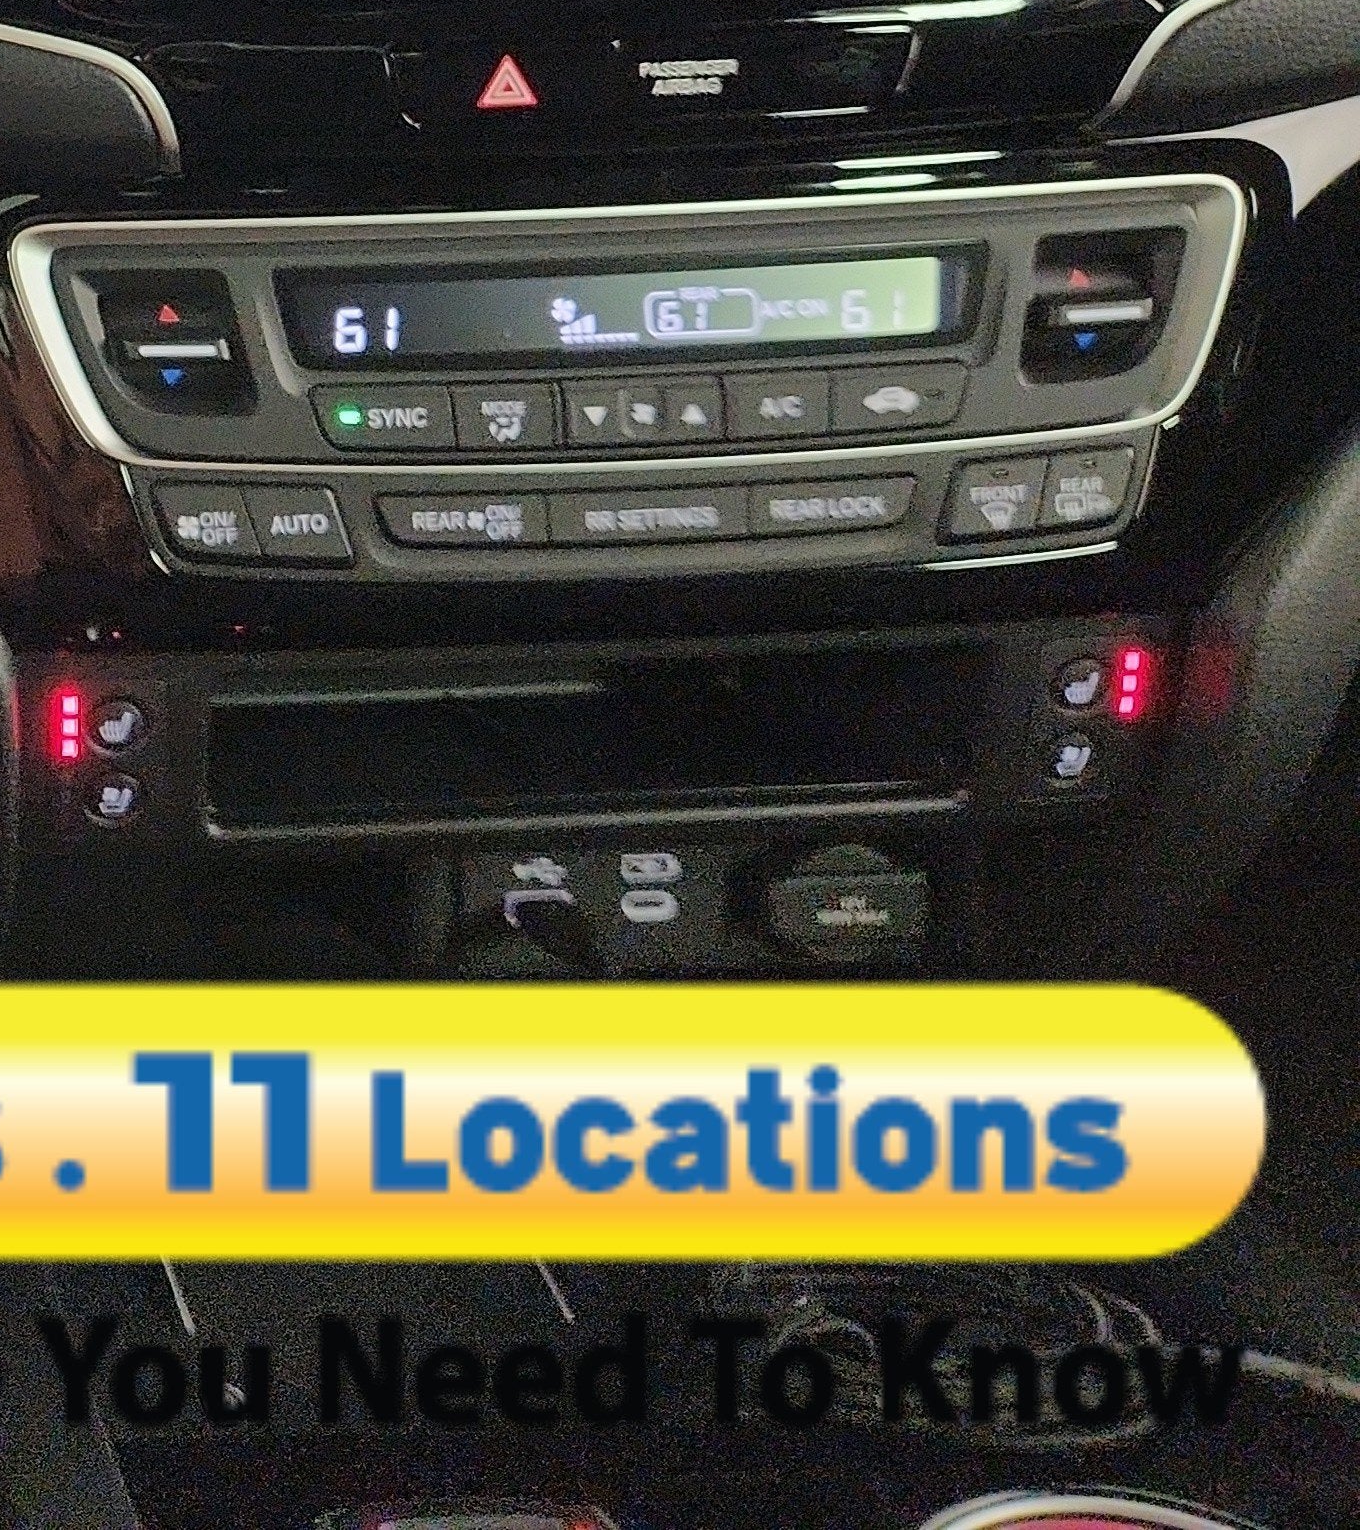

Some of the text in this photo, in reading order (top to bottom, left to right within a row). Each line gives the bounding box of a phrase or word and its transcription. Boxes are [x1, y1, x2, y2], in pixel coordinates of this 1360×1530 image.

[656, 300, 709, 333] 61
[839, 288, 906, 332] 61
[332, 305, 400, 355] 61
[368, 407, 429, 430] SYNC
[270, 513, 330, 537] AUTO
[411, 511, 469, 532] REAR
[201, 528, 238, 547] OFF
